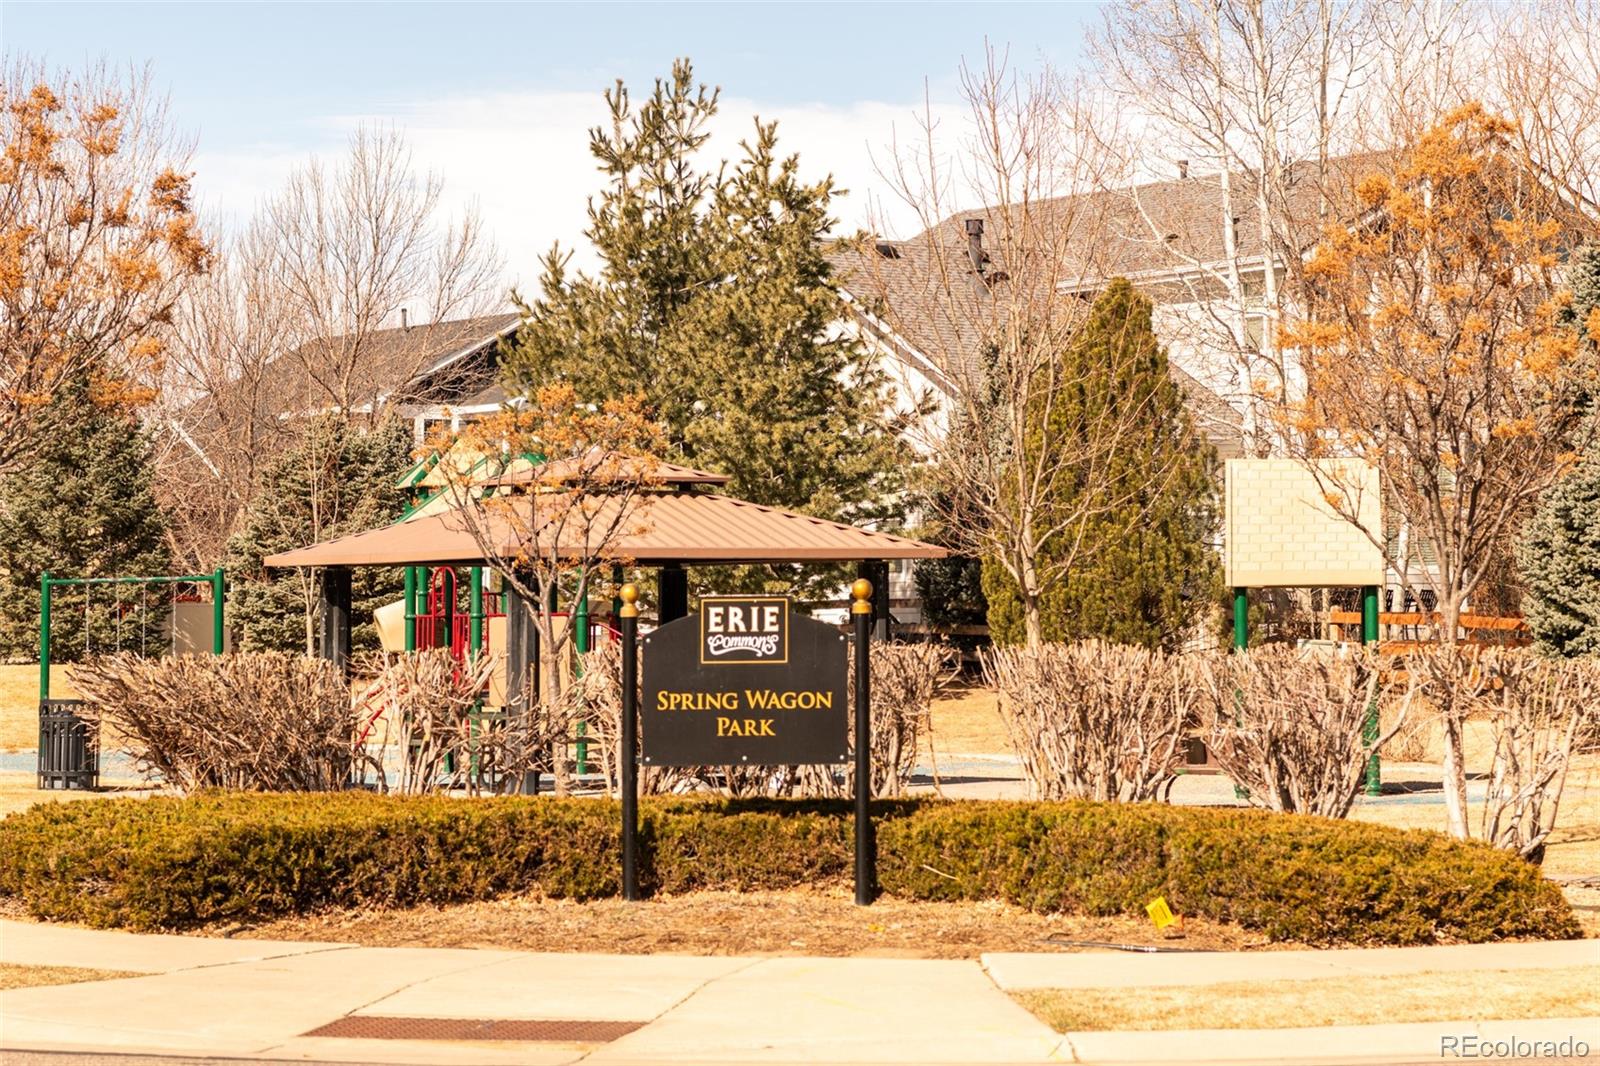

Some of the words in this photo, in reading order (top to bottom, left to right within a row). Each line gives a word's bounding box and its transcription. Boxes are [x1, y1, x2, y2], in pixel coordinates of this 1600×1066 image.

[708, 606, 779, 633] ERIE
[657, 690, 739, 711] SPRING
[744, 690, 833, 710] WAGON
[716, 717, 776, 737] PARK
